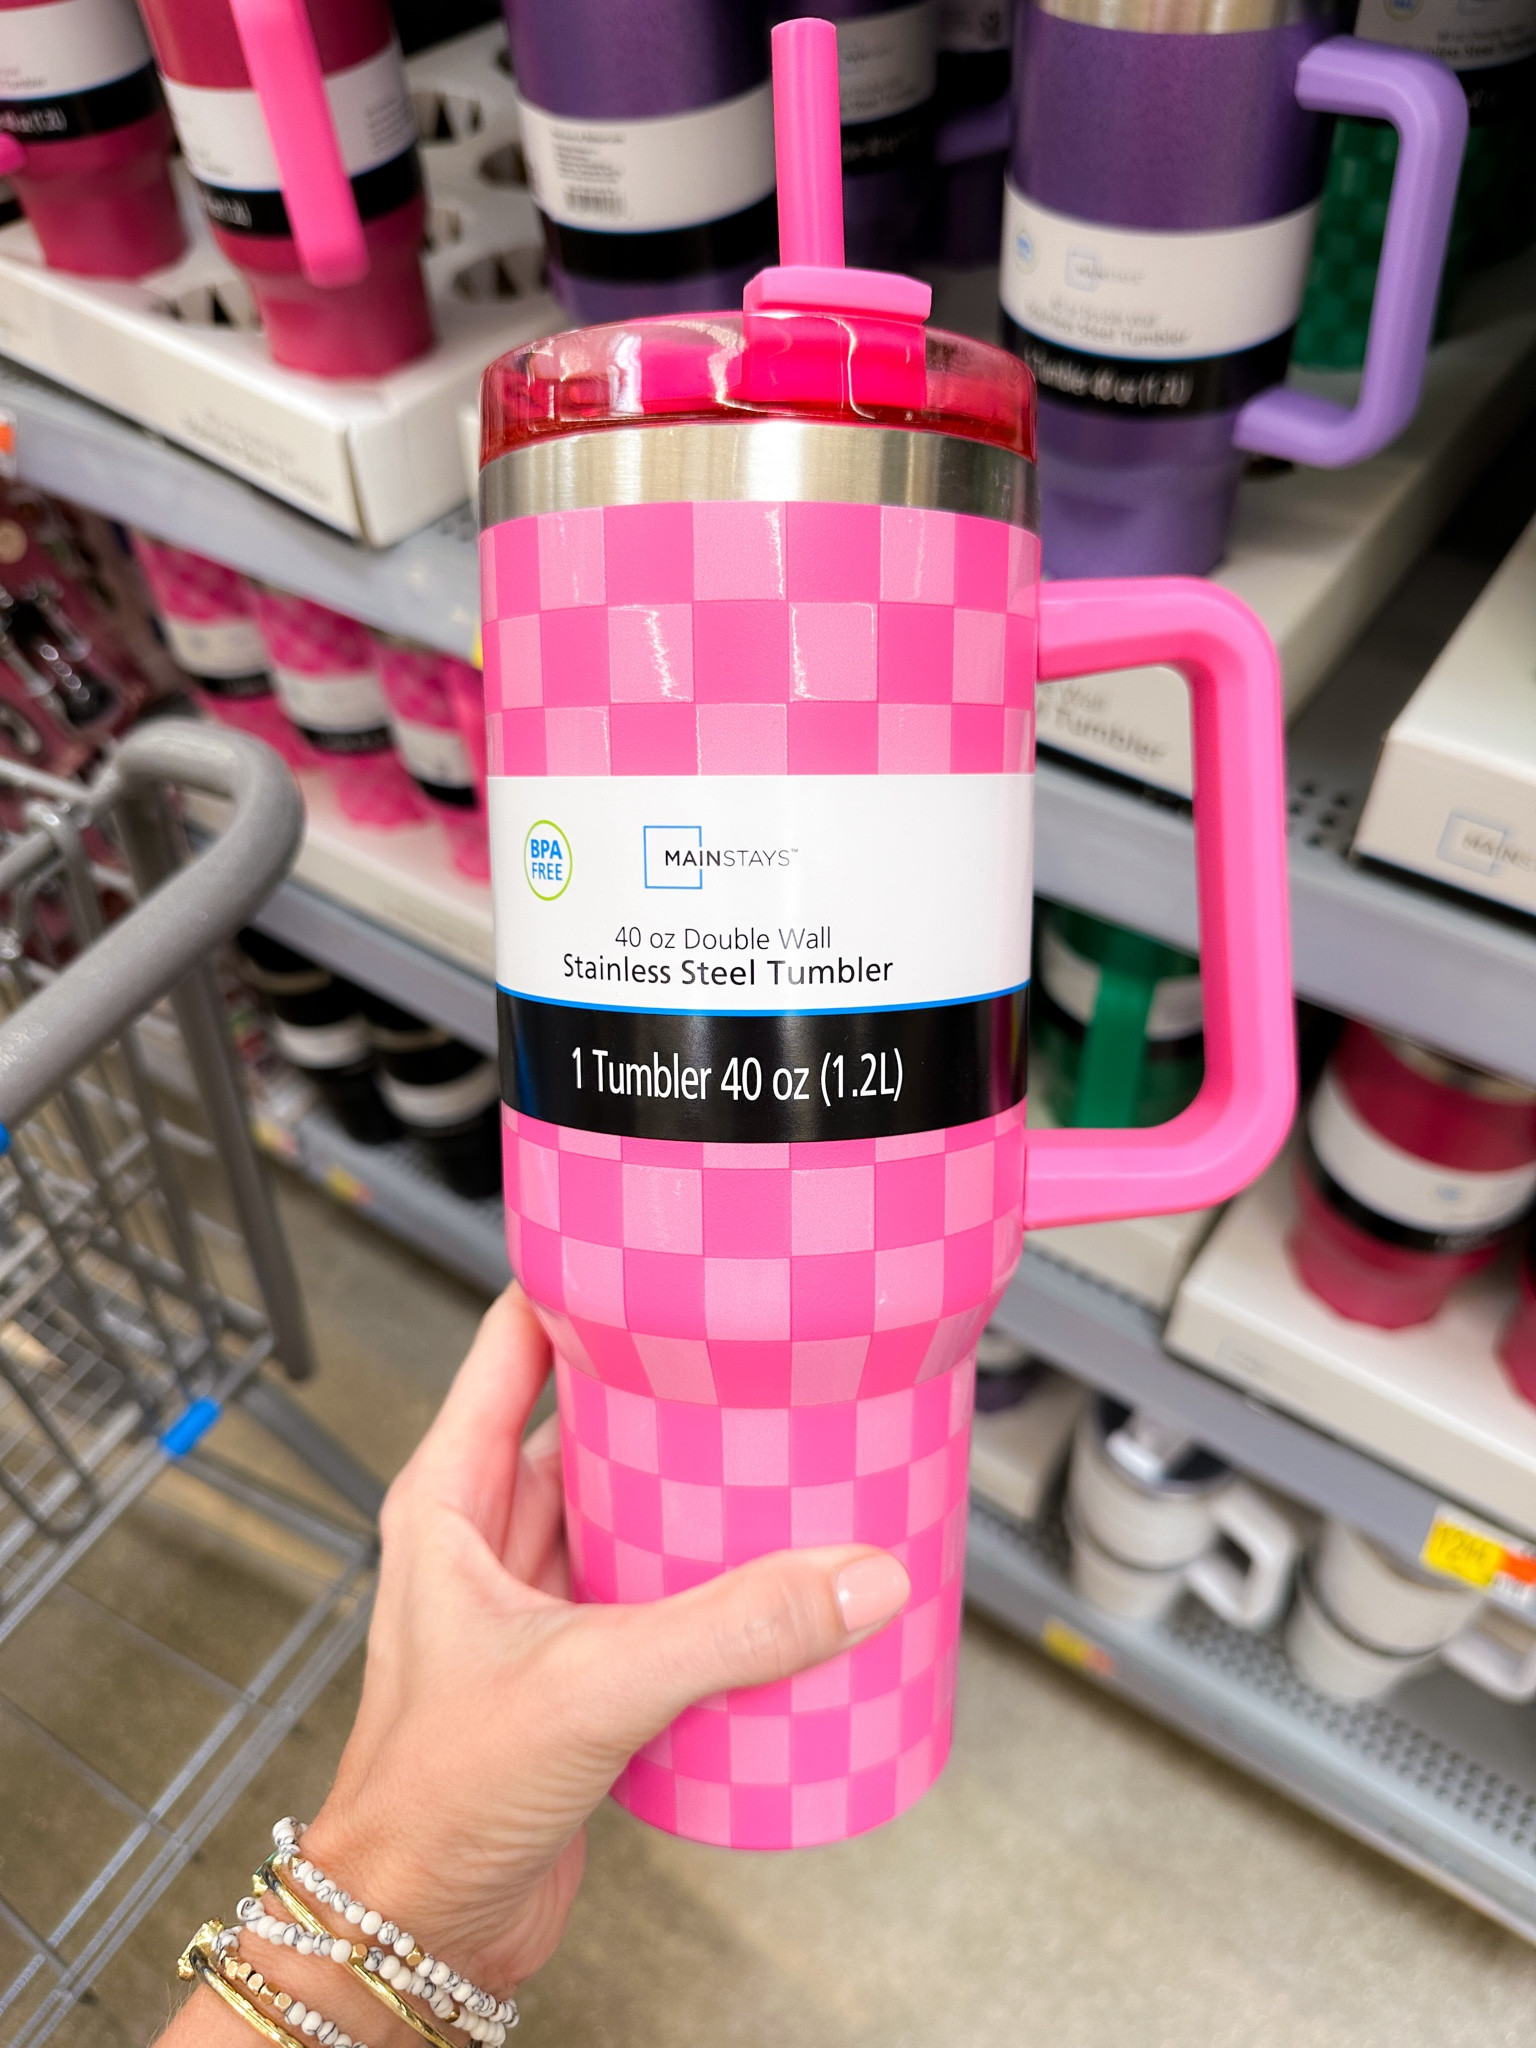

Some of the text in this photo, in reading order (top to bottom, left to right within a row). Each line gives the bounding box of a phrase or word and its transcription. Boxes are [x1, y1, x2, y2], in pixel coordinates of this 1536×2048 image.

[530, 838, 563, 859] BPA
[531, 862, 563, 881] FREE
[615, 926, 831, 950] 40 oz Double Wall
[563, 953, 894, 986] Stainless Steel Tumbler
[572, 1047, 904, 1107] 1 Tumbler 40 oz (1.2L)
